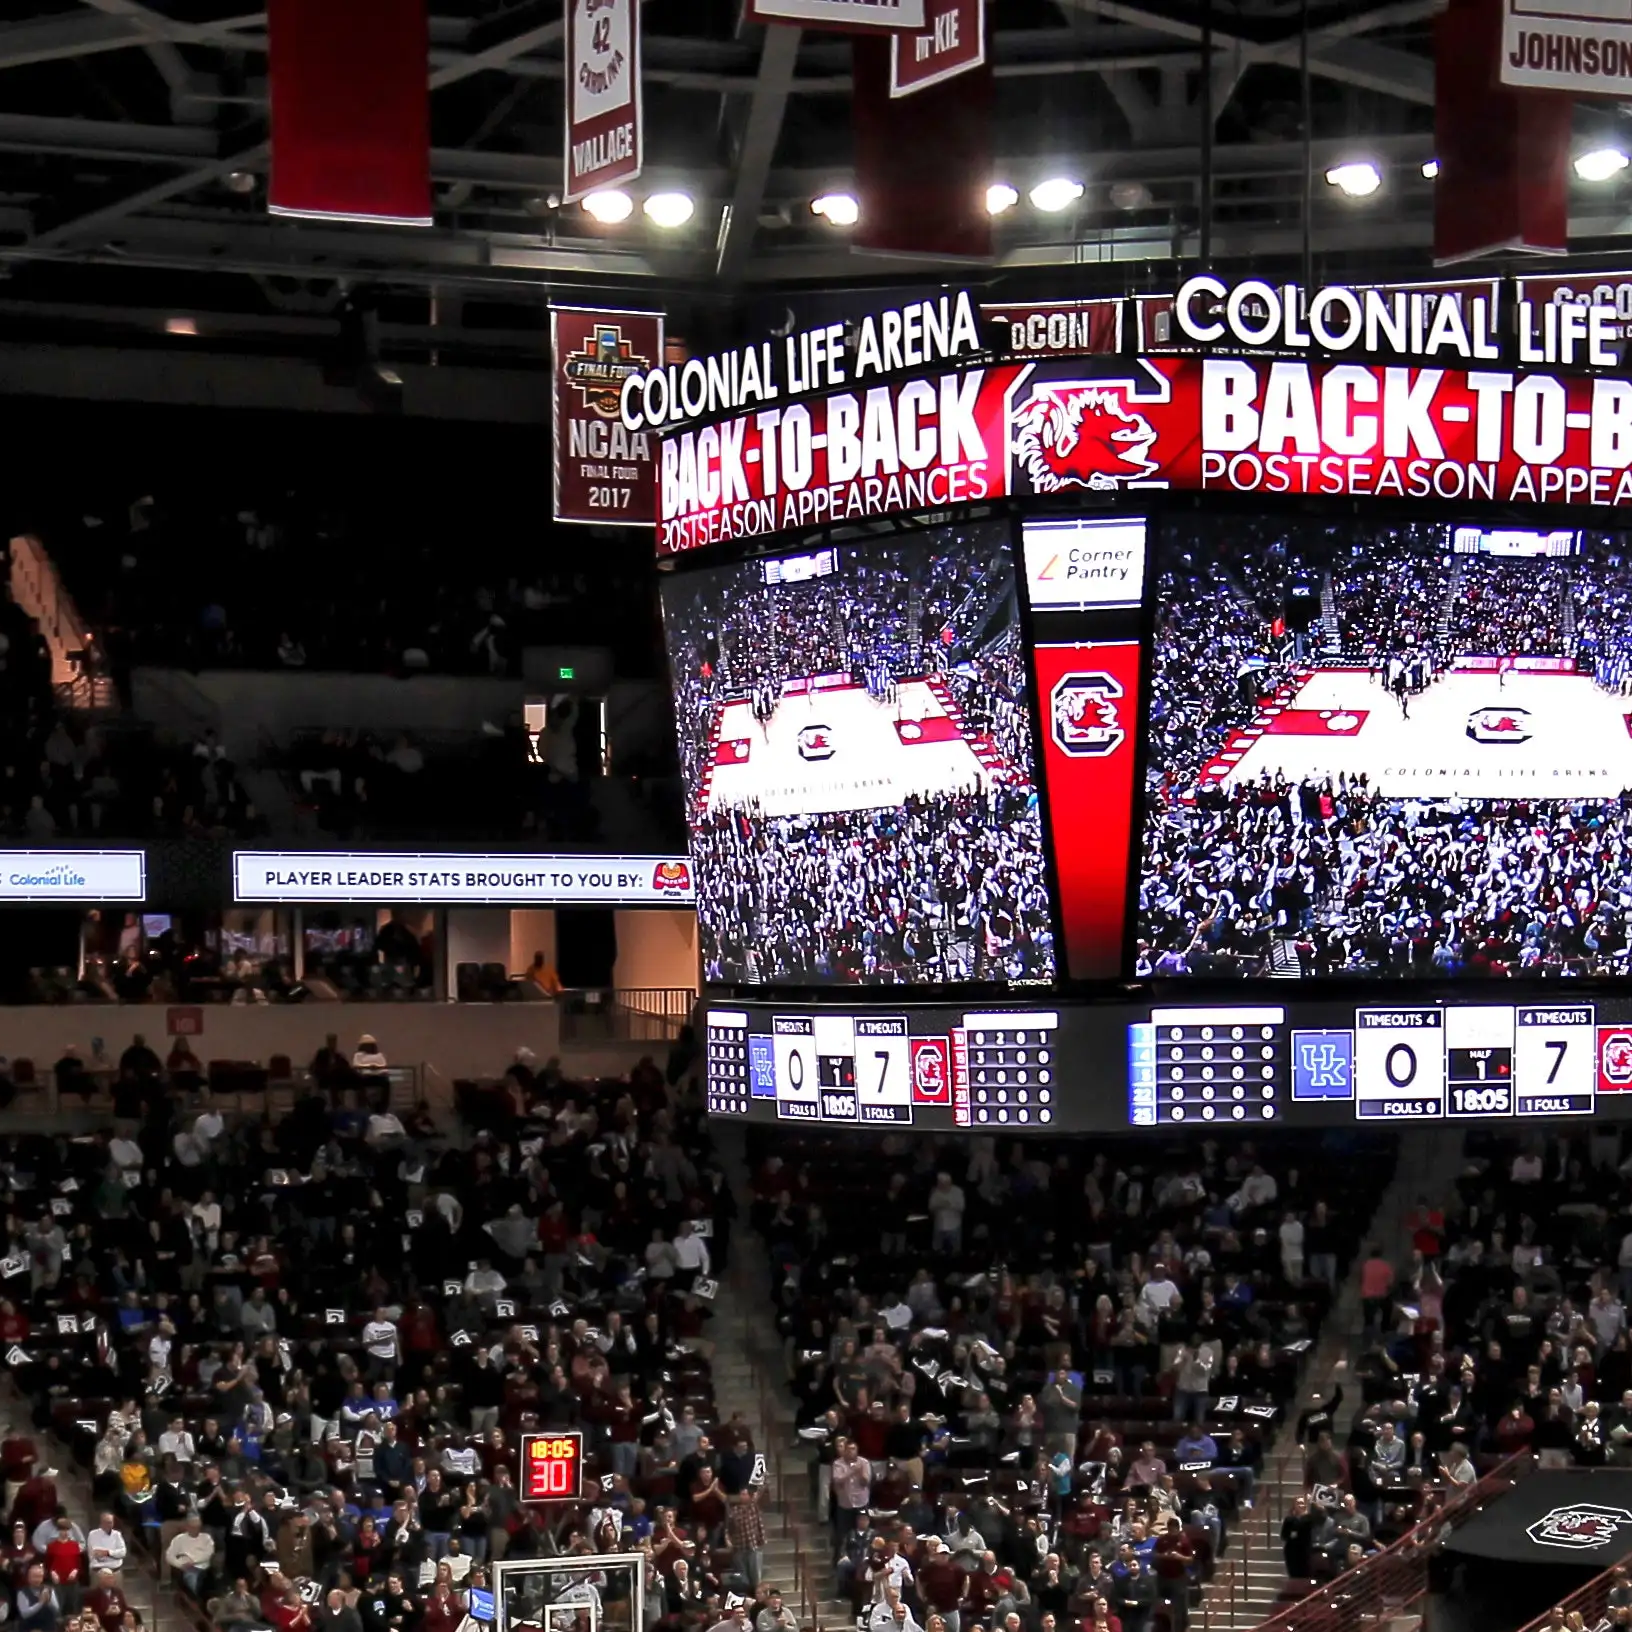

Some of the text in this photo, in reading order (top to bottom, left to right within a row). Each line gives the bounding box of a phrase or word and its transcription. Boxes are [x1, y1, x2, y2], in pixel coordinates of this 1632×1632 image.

[592, 17, 610, 53] 42
[573, 122, 632, 177] WALLACE
[1176, 276, 1499, 359] COLONIAL
[1519, 302, 1617, 366] LIFE
[577, 363, 608, 378] FINAL
[620, 291, 981, 432] COLONIAL LIFE ARENA
[569, 419, 650, 461] NCAA
[662, 368, 987, 522] BACK-TO-BACK
[580, 464, 639, 480] FINAL FOUR
[1203, 452, 1496, 501] POSTSEASON
[588, 487, 631, 508] 2017
[783, 462, 988, 528] APPEARANCES
[1069, 549, 1133, 562] Corner
[1067, 566, 1129, 581] Pantry
[10, 873, 85, 885] Colonial Life
[266, 871, 332, 886] PLAYER
[337, 871, 404, 886] LEADER
[409, 872, 460, 887] STATS
[467, 872, 546, 887] BROUGHT
[550, 873, 572, 887] TO
[577, 873, 612, 887] YOU
[617, 873, 643, 888] BY:
[1364, 1014, 1435, 1026] TIMEOUTS 4
[1523, 1012, 1587, 1024] 4 TIMEOUTS
[789, 1049, 803, 1091] 0
[875, 1051, 889, 1093] 7
[1385, 1043, 1417, 1088] 0
[1476, 1060, 1485, 1080] 1
[1545, 1041, 1567, 1084] 7
[833, 1067, 841, 1087] 1
[823, 1095, 855, 1116] 18:05
[1384, 1102, 1435, 1114] FOULS 0
[1453, 1089, 1509, 1111] 18:05
[1526, 1099, 1569, 1111] 1 FOULS
[532, 1440, 573, 1458] 18:05
[532, 1460, 567, 1492] 30
